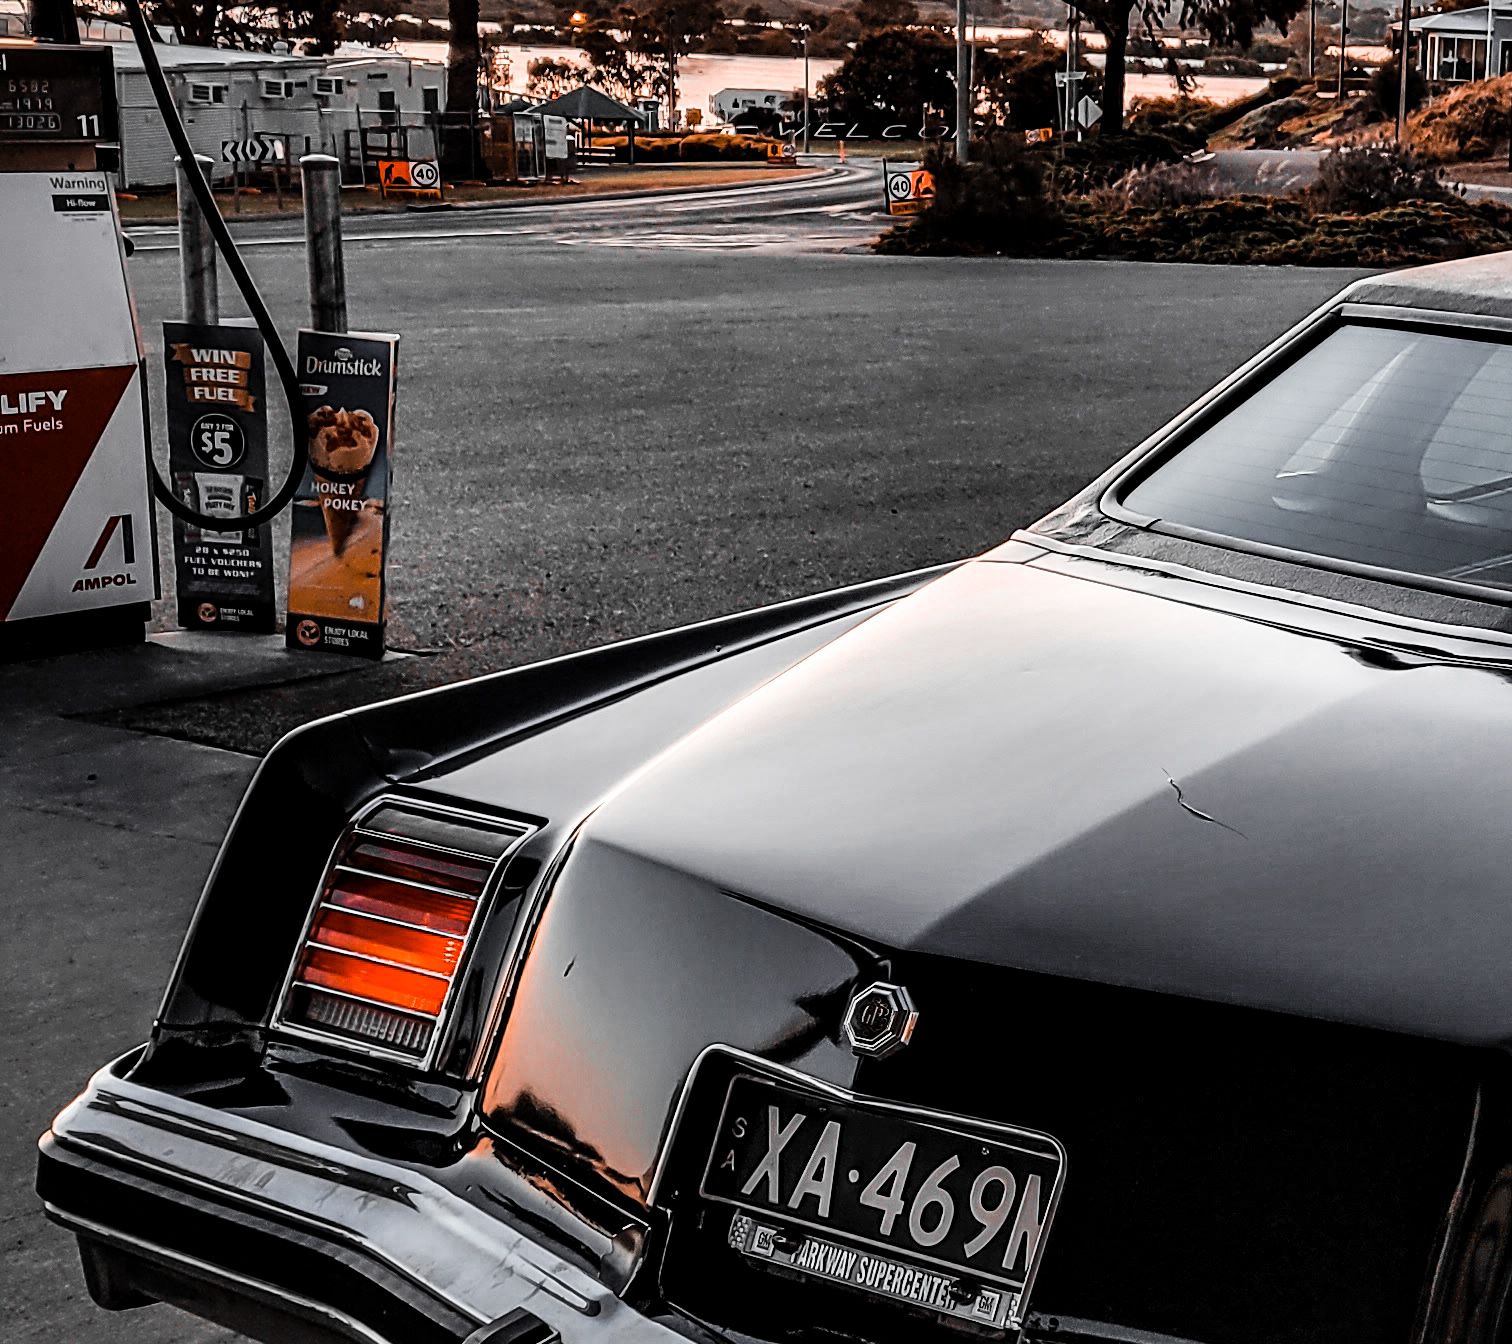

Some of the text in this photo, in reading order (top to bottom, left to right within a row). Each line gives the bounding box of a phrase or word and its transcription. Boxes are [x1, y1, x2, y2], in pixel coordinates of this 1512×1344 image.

[77, 114, 99, 137] 11
[779, 121, 958, 139] WELCO
[416, 168, 435, 180] 40
[50, 177, 106, 192] Warning
[893, 180, 908, 193] 40
[190, 348, 236, 365] WIN
[306, 356, 382, 377] Drumstick
[190, 367, 241, 384] FREE
[194, 386, 239, 402] FUEL
[23, 416, 64, 433] Fuels
[201, 431, 233, 465] $5
[311, 481, 356, 495] HOKEY
[323, 498, 368, 512] POKEY
[72, 573, 137, 593] AMPOL
[978, 1295, 996, 1313] GM
